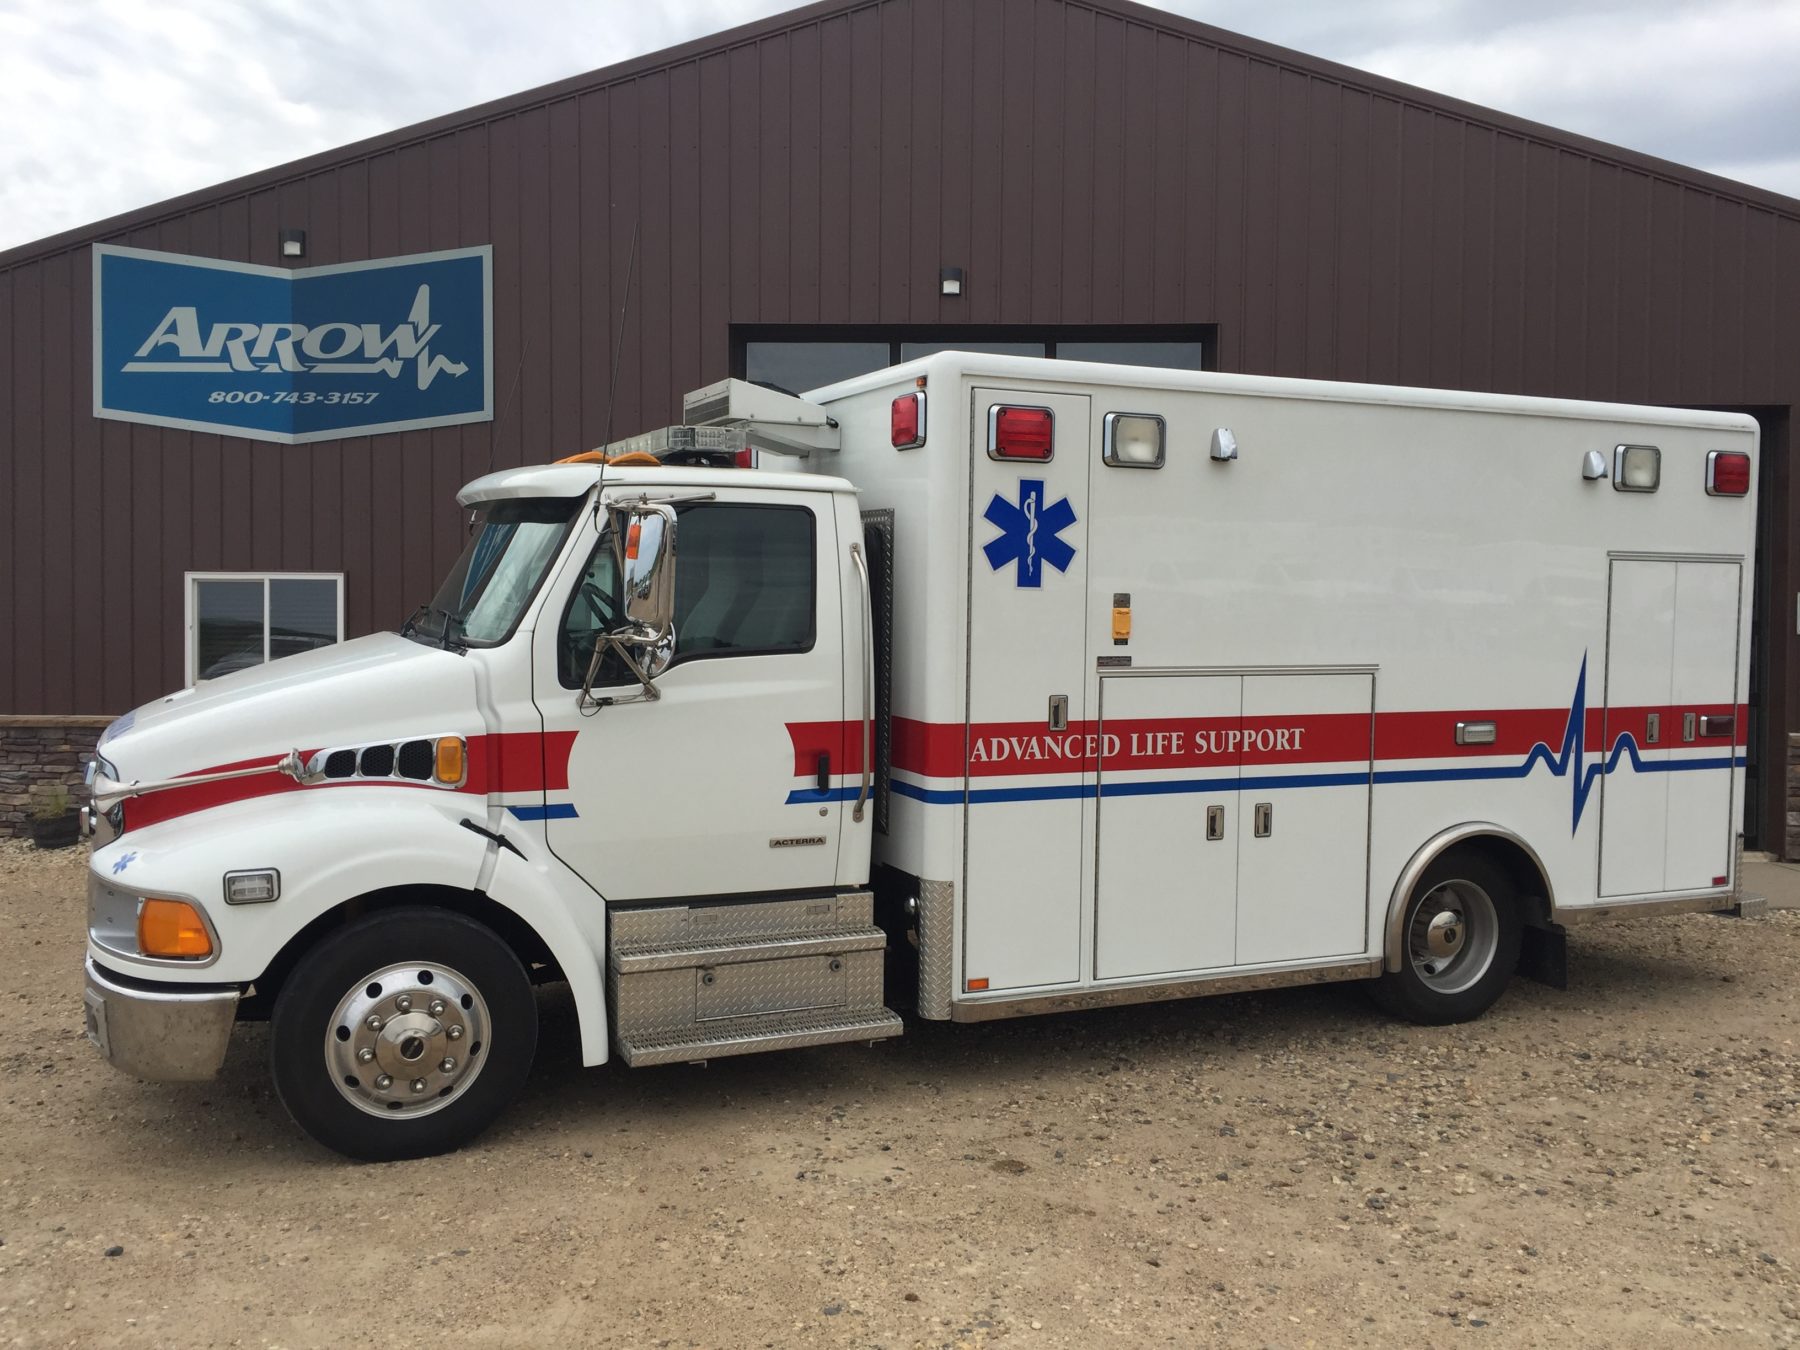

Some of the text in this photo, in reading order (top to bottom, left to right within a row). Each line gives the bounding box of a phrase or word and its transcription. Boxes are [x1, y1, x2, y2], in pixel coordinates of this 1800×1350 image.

[134, 306, 441, 371] ARROW
[208, 391, 379, 404] 800-743-3157
[970, 728, 1305, 762] ADVANCED LIFE SUPPORT
[774, 837, 824, 847] ACTERRA
